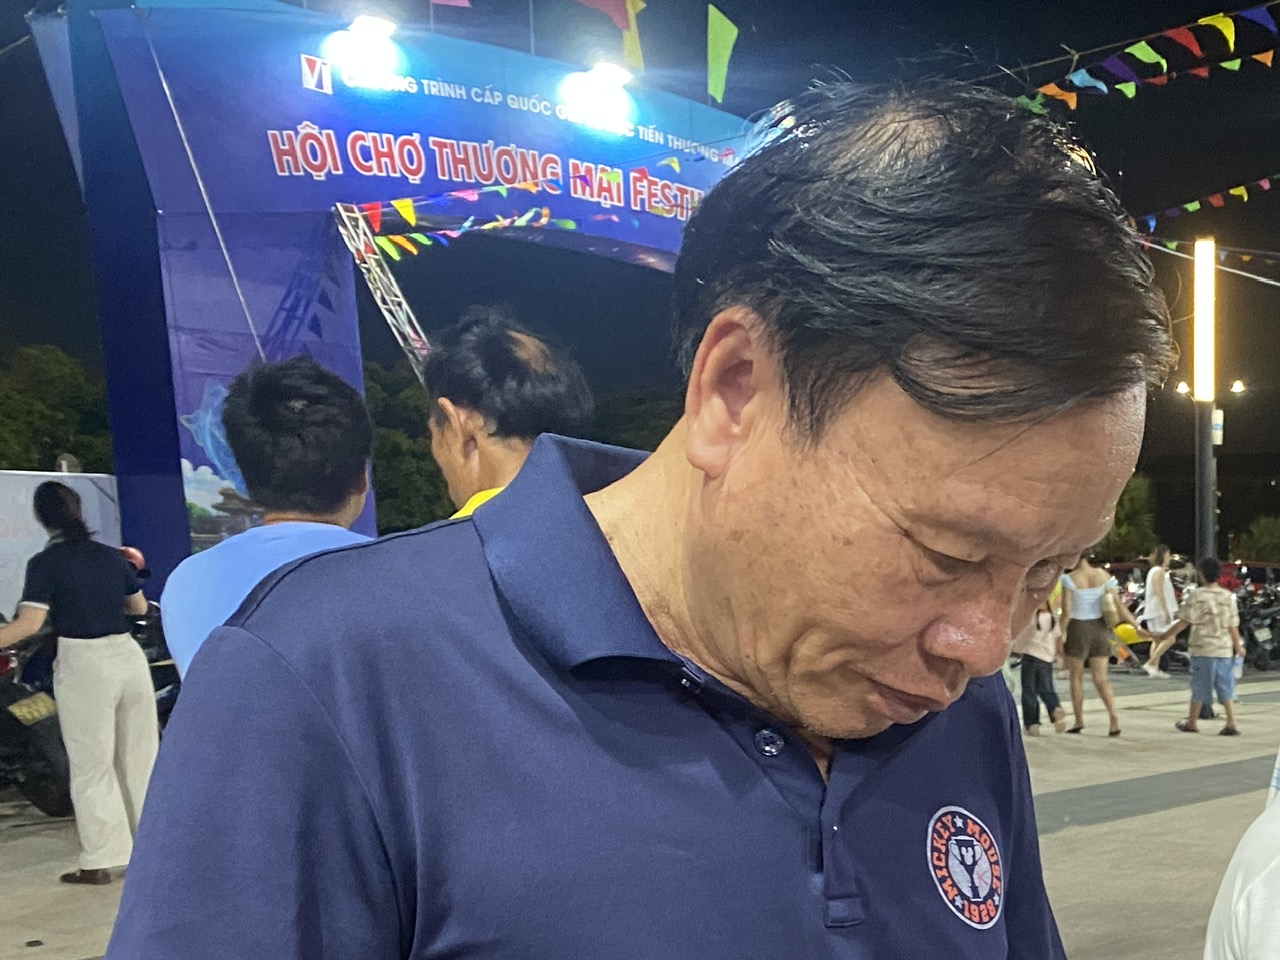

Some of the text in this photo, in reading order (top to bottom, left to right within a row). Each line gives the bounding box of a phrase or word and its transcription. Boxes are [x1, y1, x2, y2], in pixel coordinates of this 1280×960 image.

[421, 77, 467, 100] TRÌNH
[471, 85, 503, 106] CẤP
[507, 94, 551, 116] QUỐC
[637, 124, 665, 146] TIẾN
[267, 120, 343, 181] HỘI
[347, 130, 426, 184] CHỢ
[428, 135, 562, 195] THƯƠNG
[568, 157, 624, 208] MẠI
[963, 898, 997, 924] 1928
